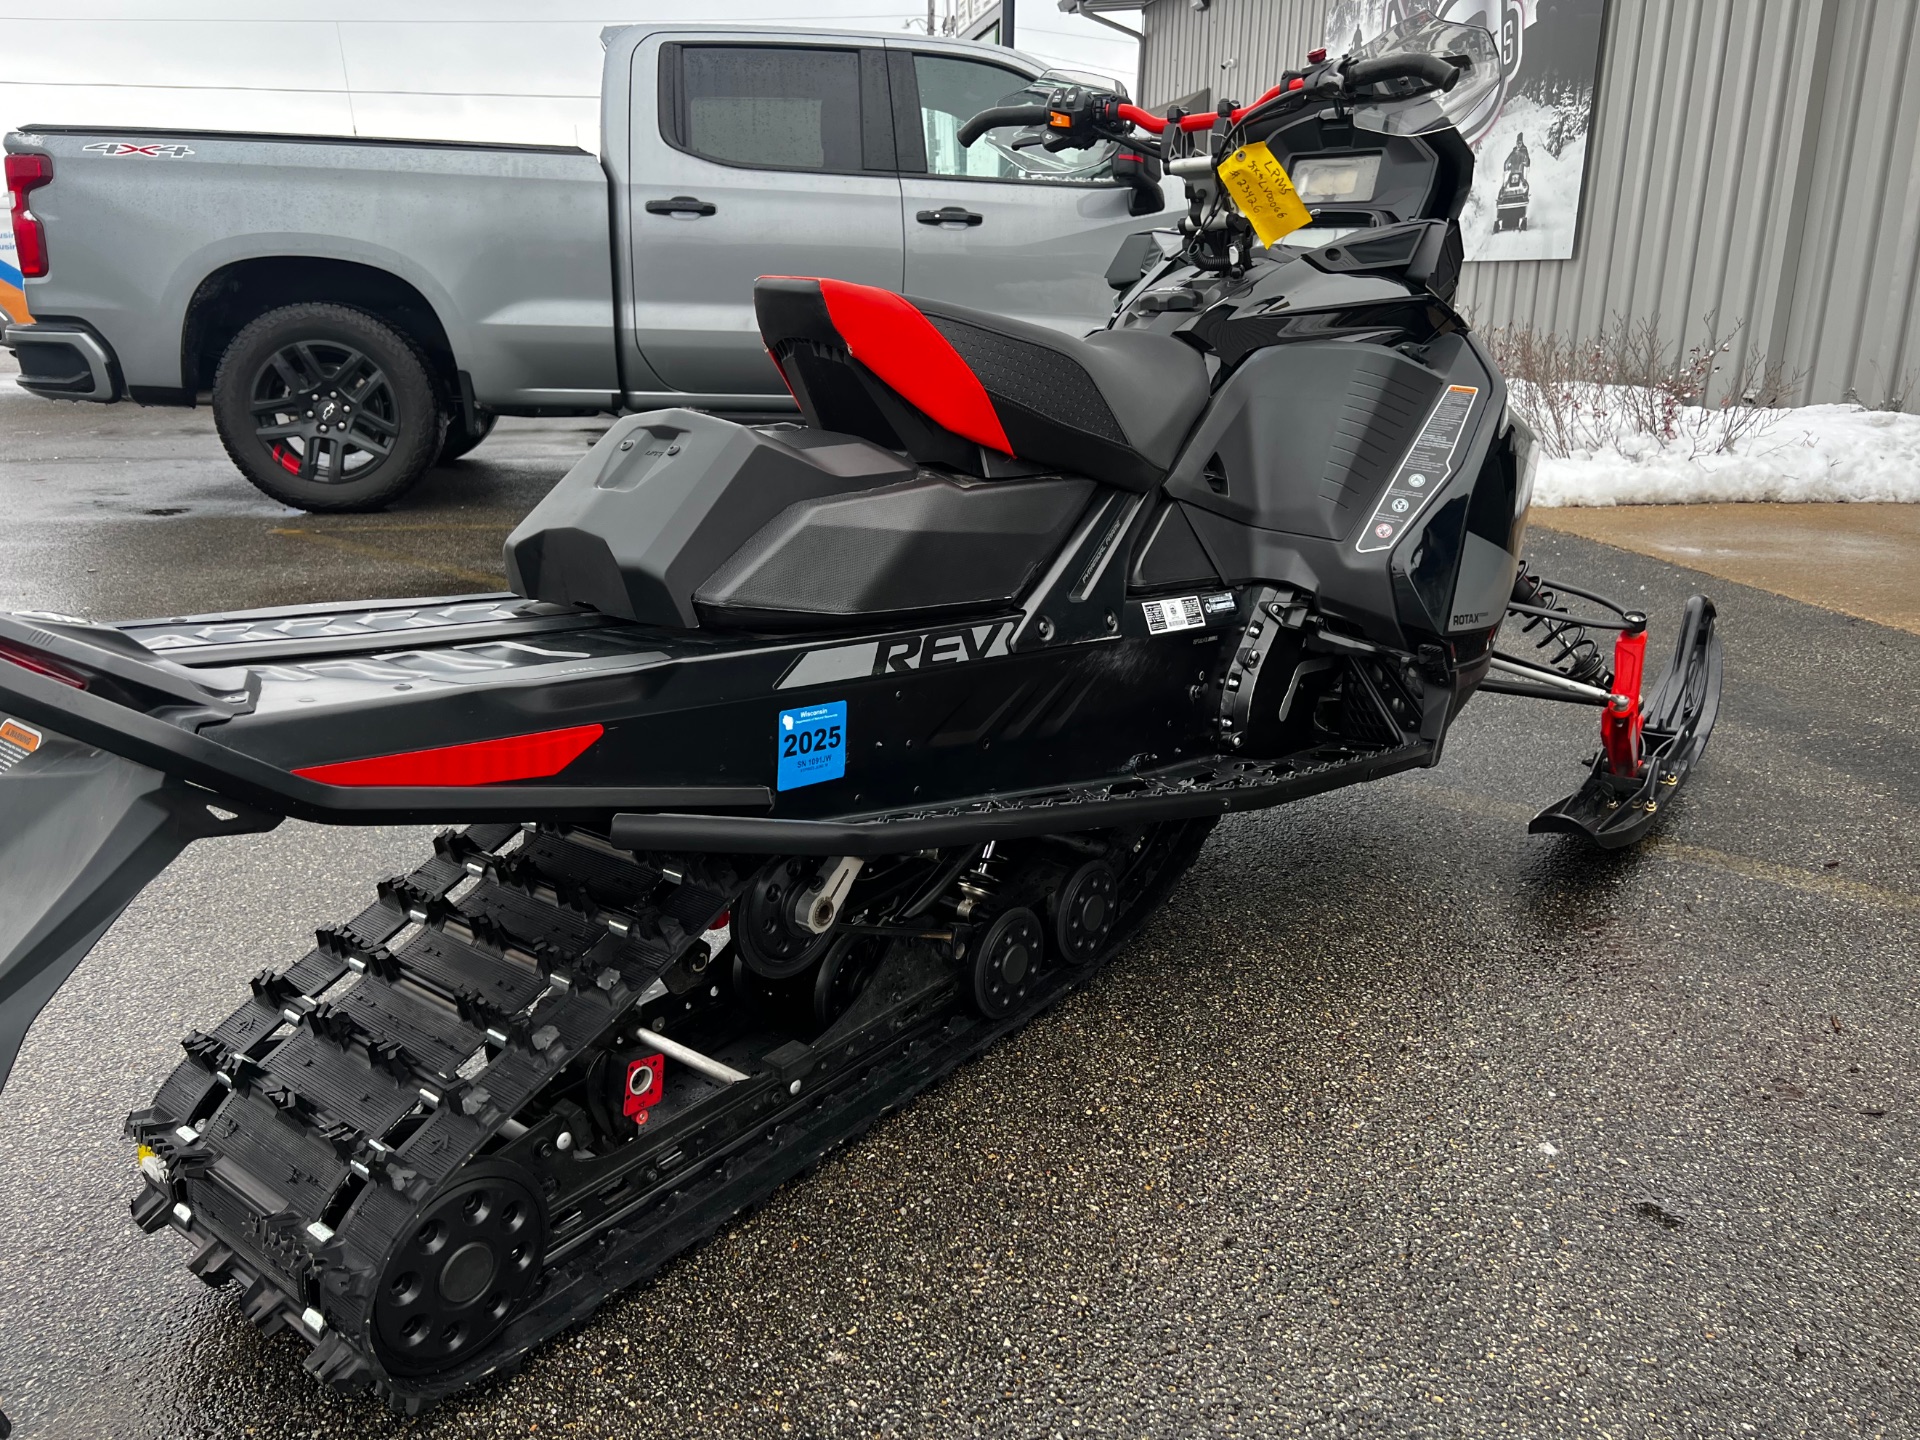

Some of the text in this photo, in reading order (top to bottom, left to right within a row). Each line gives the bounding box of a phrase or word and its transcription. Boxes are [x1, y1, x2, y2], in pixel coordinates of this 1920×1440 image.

[1453, 613, 1479, 626] ROTAX
[870, 624, 1005, 676] REV
[800, 708, 828, 718] Wisconsin
[783, 725, 841, 758] 2025
